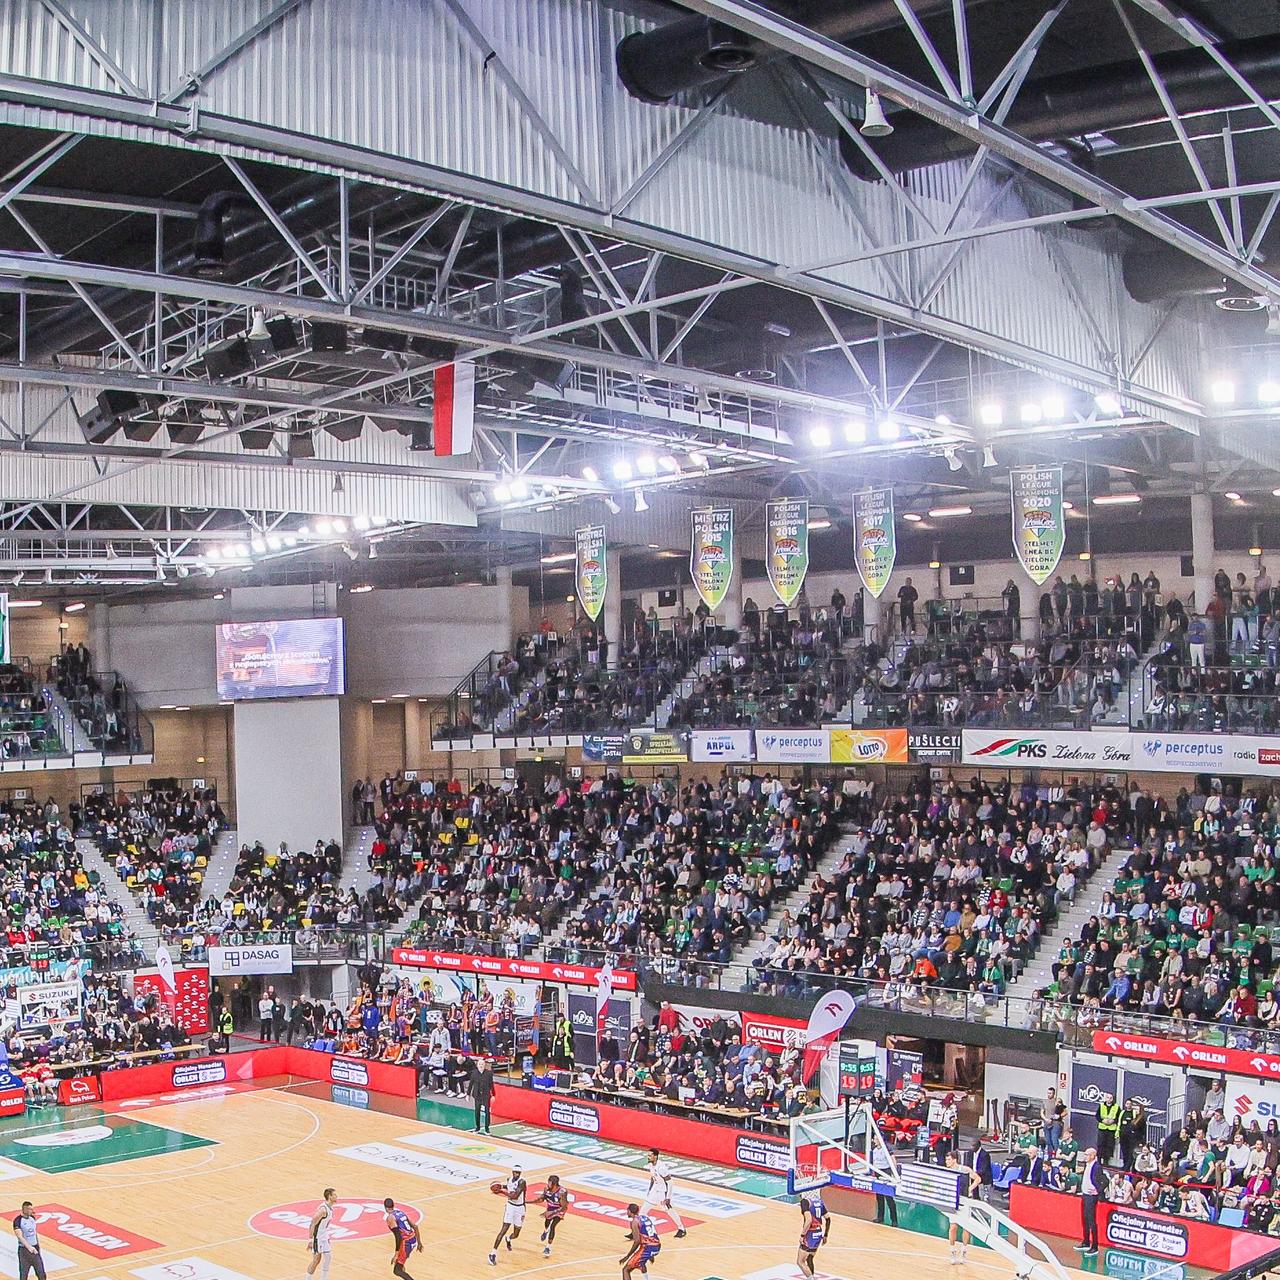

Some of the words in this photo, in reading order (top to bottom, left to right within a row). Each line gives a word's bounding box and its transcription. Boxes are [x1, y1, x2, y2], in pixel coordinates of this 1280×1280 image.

[1020, 471, 1053, 482] POLISH
[1023, 497, 1052, 508] 2020
[694, 512, 730, 524] MISTRZ
[863, 515, 884, 526] 2017
[694, 522, 729, 534] POLSKI
[776, 527, 798, 537] 2016
[701, 533, 722, 543] 2015
[706, 741, 735, 751] ARPOL
[779, 736, 823, 750] perceptus
[858, 742, 880, 756] LOTTO
[1017, 744, 1048, 758] PKS
[1052, 744, 1097, 760] Zielona
[1102, 745, 1131, 761] Góra
[1165, 742, 1224, 756] perceptus
[1233, 750, 1256, 760] radio
[242, 950, 280, 960] DASAG
[408, 954, 426, 962] ORLEN
[442, 957, 461, 966] ORLEN
[482, 961, 502, 970] ORLEN
[519, 965, 540, 974] ORLEN
[563, 969, 585, 979] ORLEN
[38, 989, 74, 999] SUZUKI
[749, 1024, 782, 1041] ORLEN
[1123, 1041, 1157, 1054] ORLEN
[1191, 1051, 1226, 1064] ORLEN
[840, 1062, 857, 1073] 9:55
[859, 1062, 874, 1073] 9:55
[175, 1074, 198, 1084] ORLEN
[841, 1075, 857, 1089] 19
[860, 1075, 874, 1088] 19
[0, 1097, 23, 1108] ORLEN
[551, 1112, 573, 1124] ORLEN
[739, 1137, 763, 1150] Oficjalny
[739, 1150, 765, 1163] ORLEN
[383, 1152, 429, 1169] Bank
[426, 1161, 480, 1181] Pekao
[1111, 1213, 1146, 1230] Oficjalny
[1146, 1220, 1184, 1236] Menedżer
[57, 1222, 132, 1250] ORLEN
[1111, 1228, 1145, 1244] ORLEN
